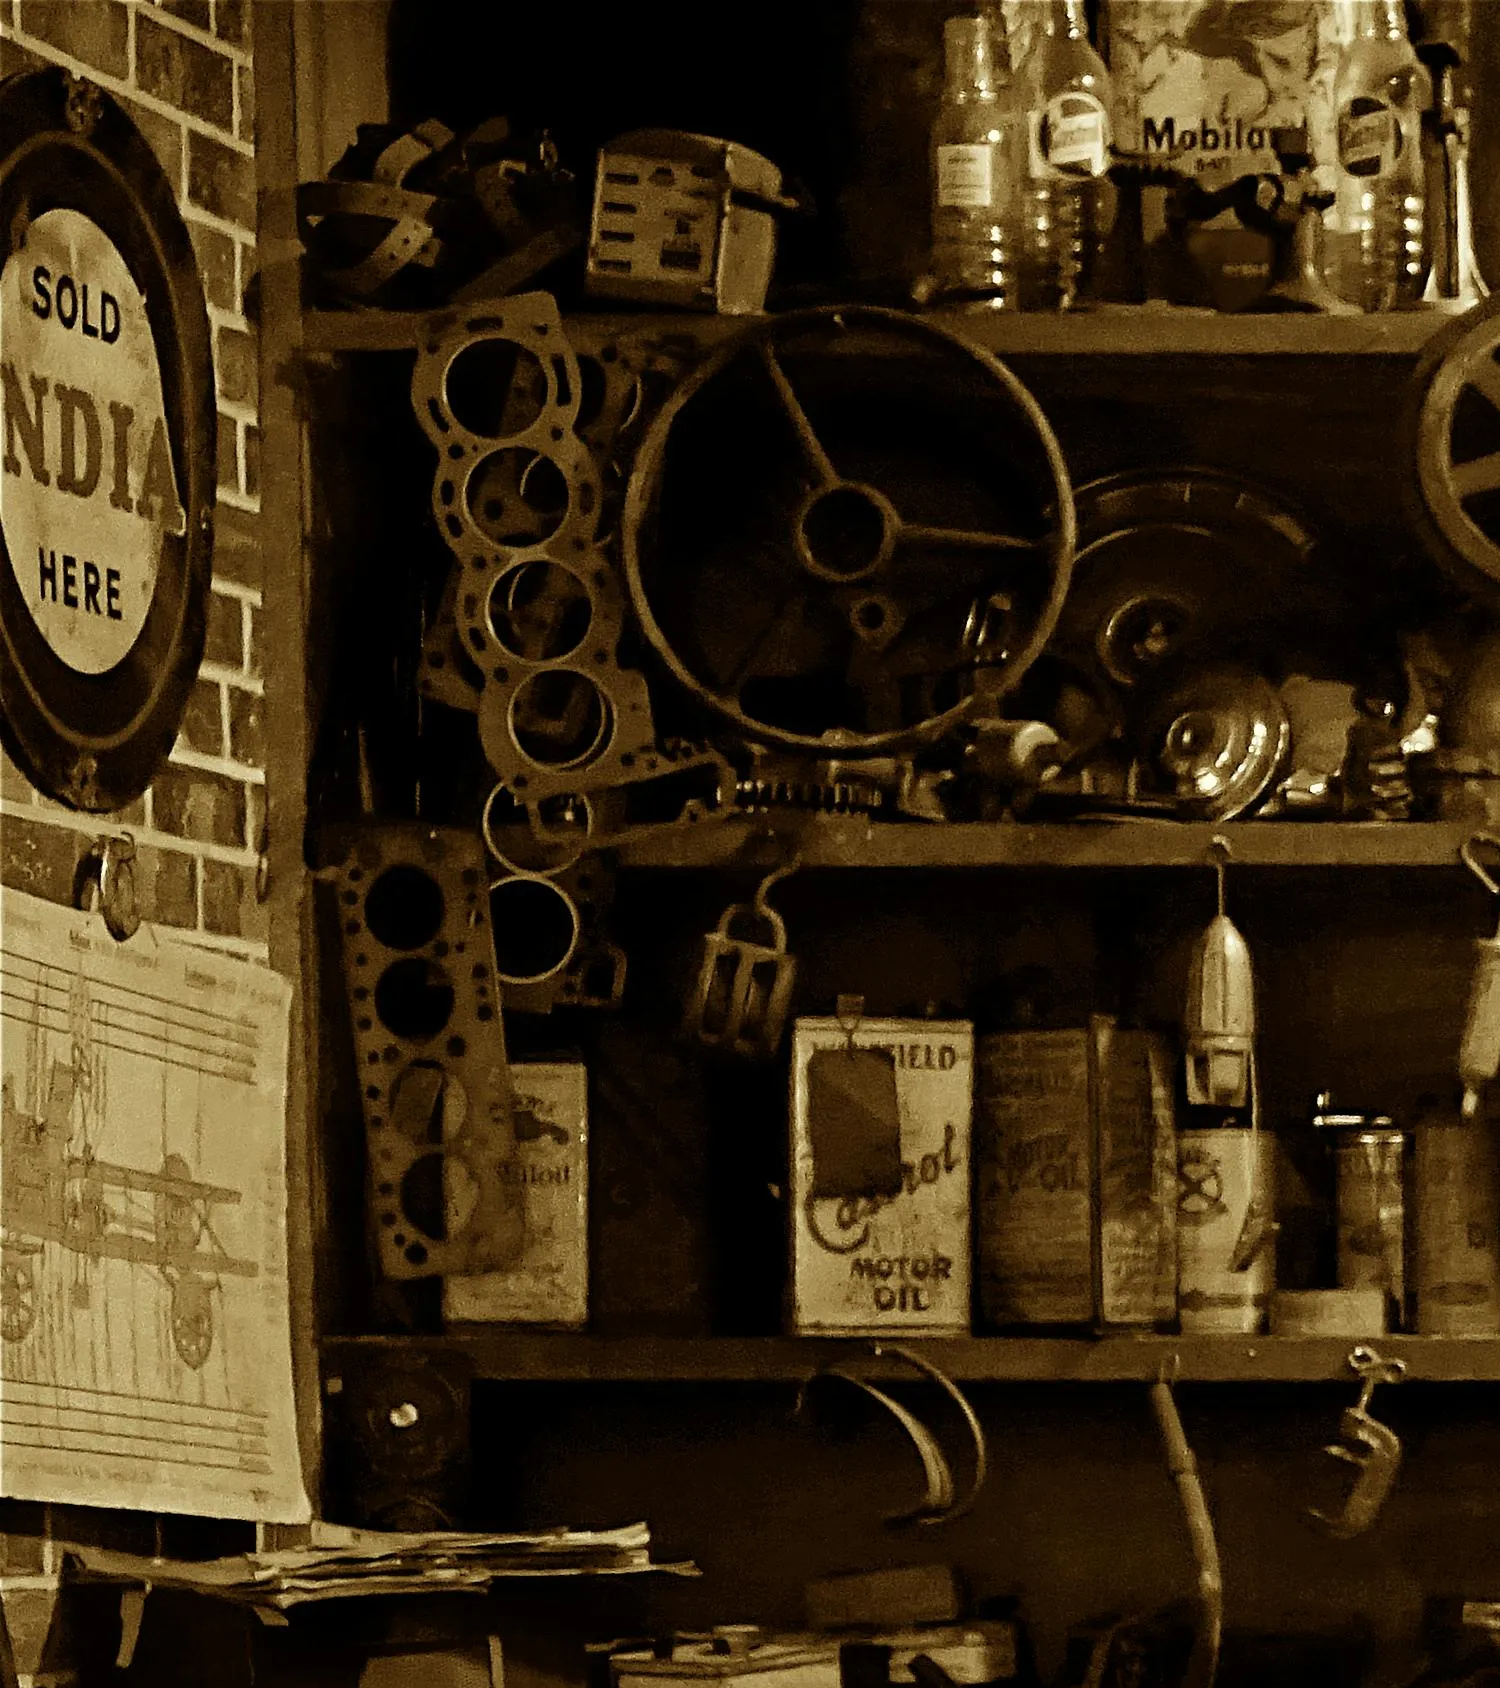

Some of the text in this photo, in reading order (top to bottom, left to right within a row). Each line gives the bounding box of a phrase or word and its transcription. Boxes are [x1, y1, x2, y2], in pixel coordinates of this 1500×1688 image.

[1143, 115, 1308, 151] Mobilo
[32, 265, 121, 345] SOLD
[38, 547, 122, 620] HERE
[804, 1122, 961, 1254] Carol
[851, 1256, 952, 1281] MOTOR
[873, 1286, 931, 1313] OIL
